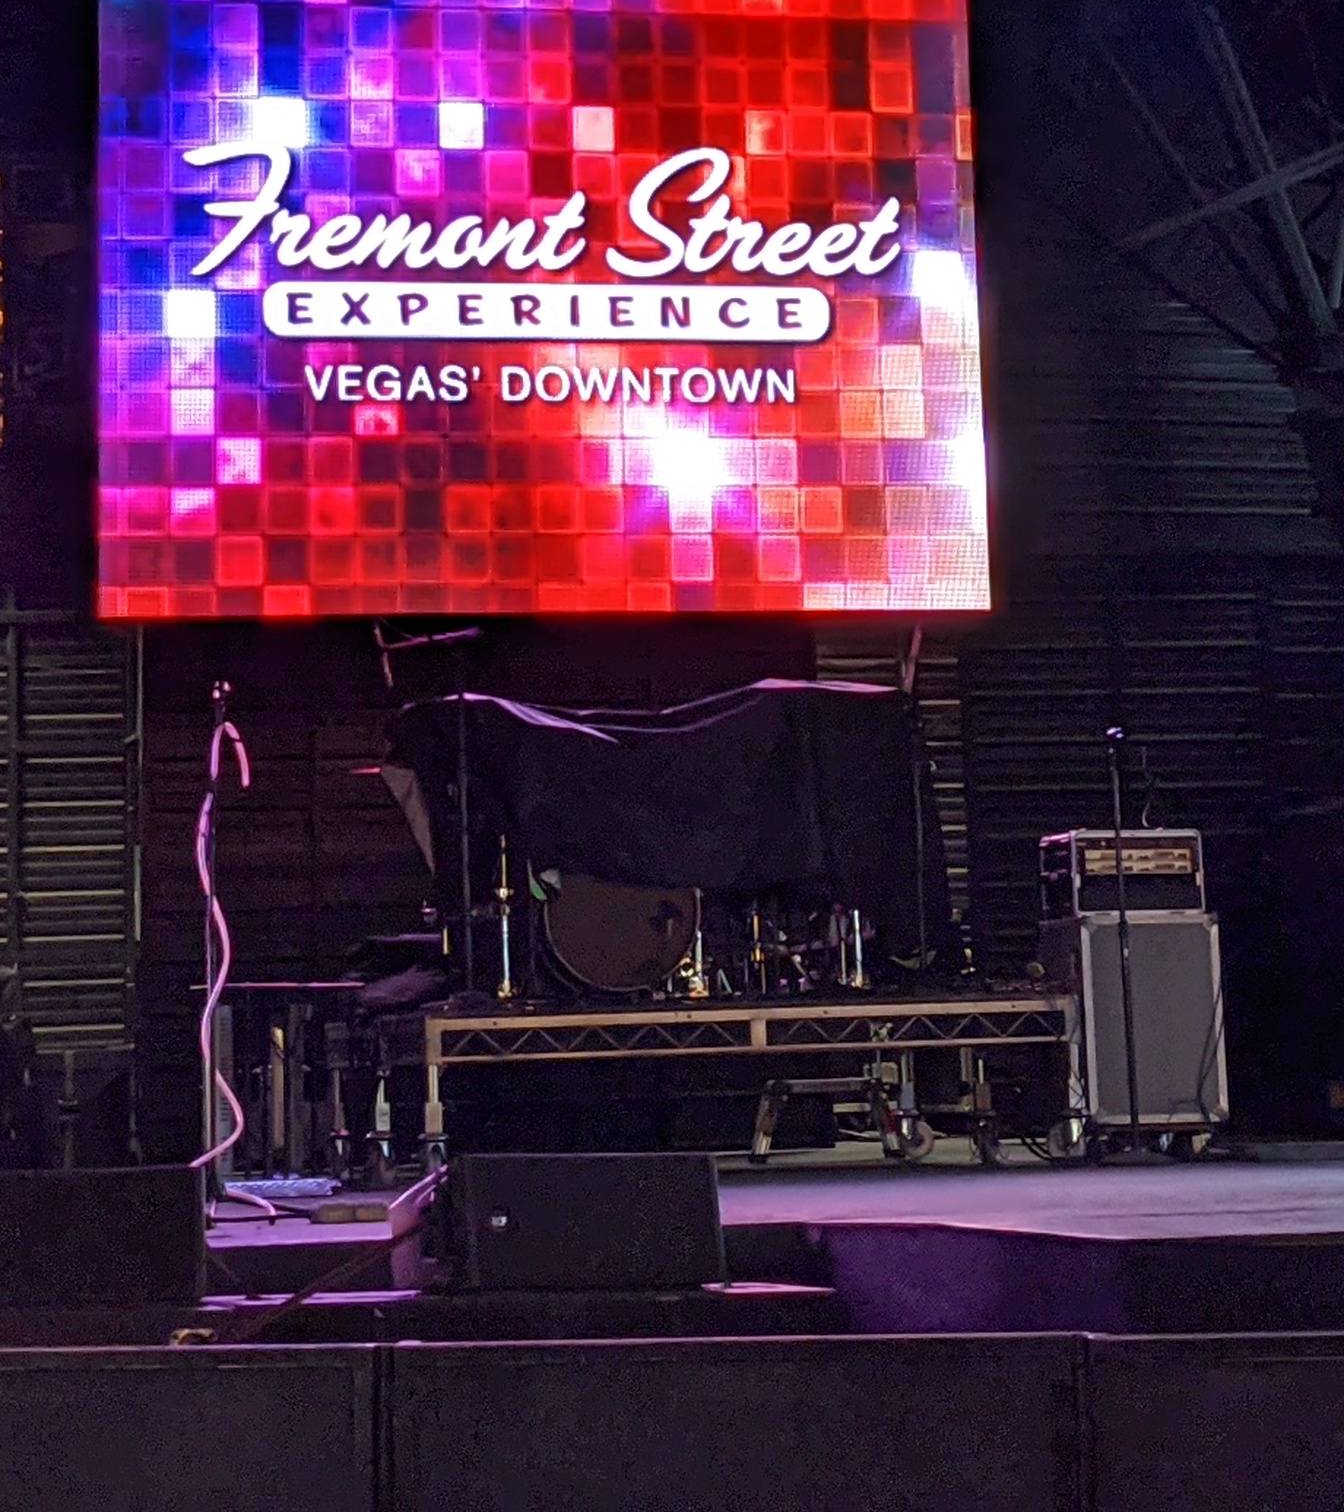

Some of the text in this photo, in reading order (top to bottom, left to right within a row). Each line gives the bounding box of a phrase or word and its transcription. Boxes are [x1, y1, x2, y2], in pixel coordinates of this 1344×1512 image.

[181, 140, 904, 278] Fremont Street
[285, 291, 804, 331] EXPERIENCE
[304, 364, 797, 405] VEGAS' DOWNTOWN
